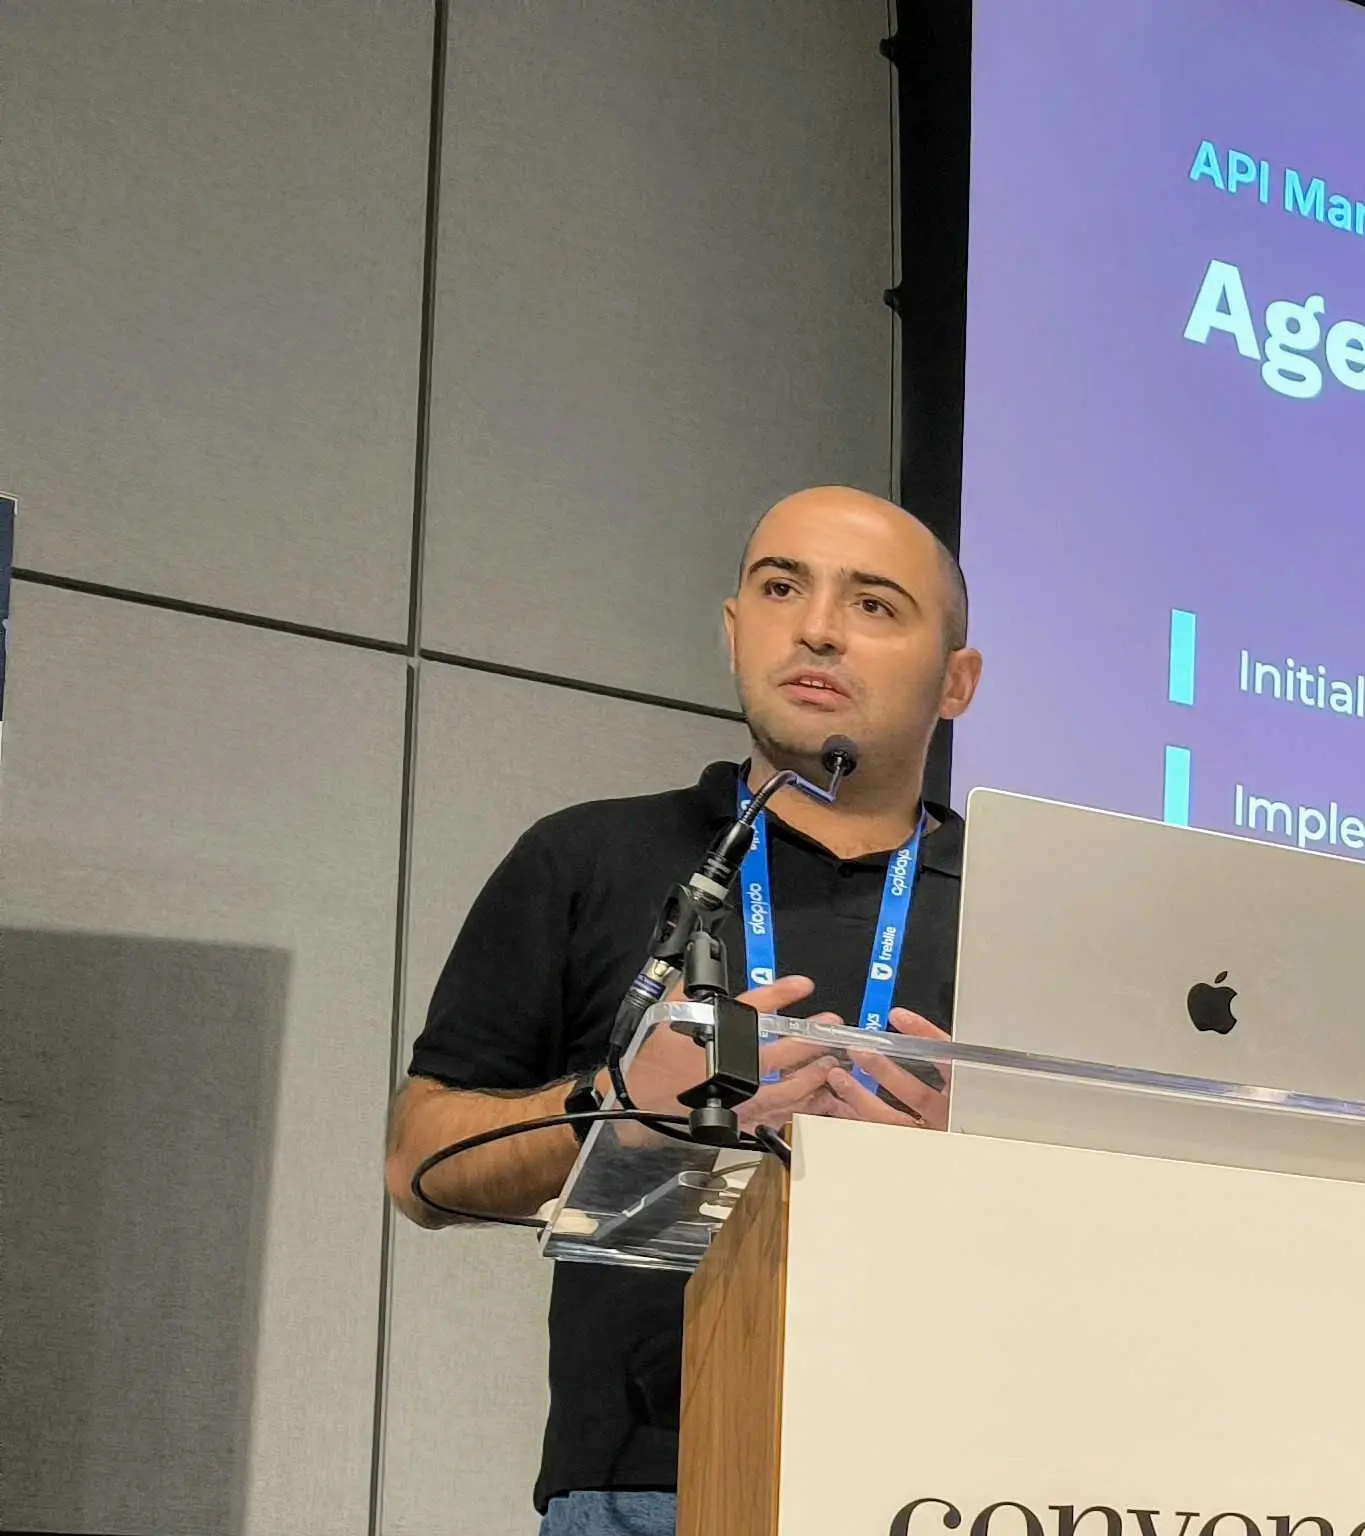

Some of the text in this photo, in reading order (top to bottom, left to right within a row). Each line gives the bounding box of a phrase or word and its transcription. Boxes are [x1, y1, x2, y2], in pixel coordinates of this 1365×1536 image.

[1190, 139, 1270, 206] API
[1239, 650, 1365, 719] Initial
[892, 848, 910, 896] apidays
[750, 883, 765, 935] apidays
[879, 926, 896, 961] treblle
